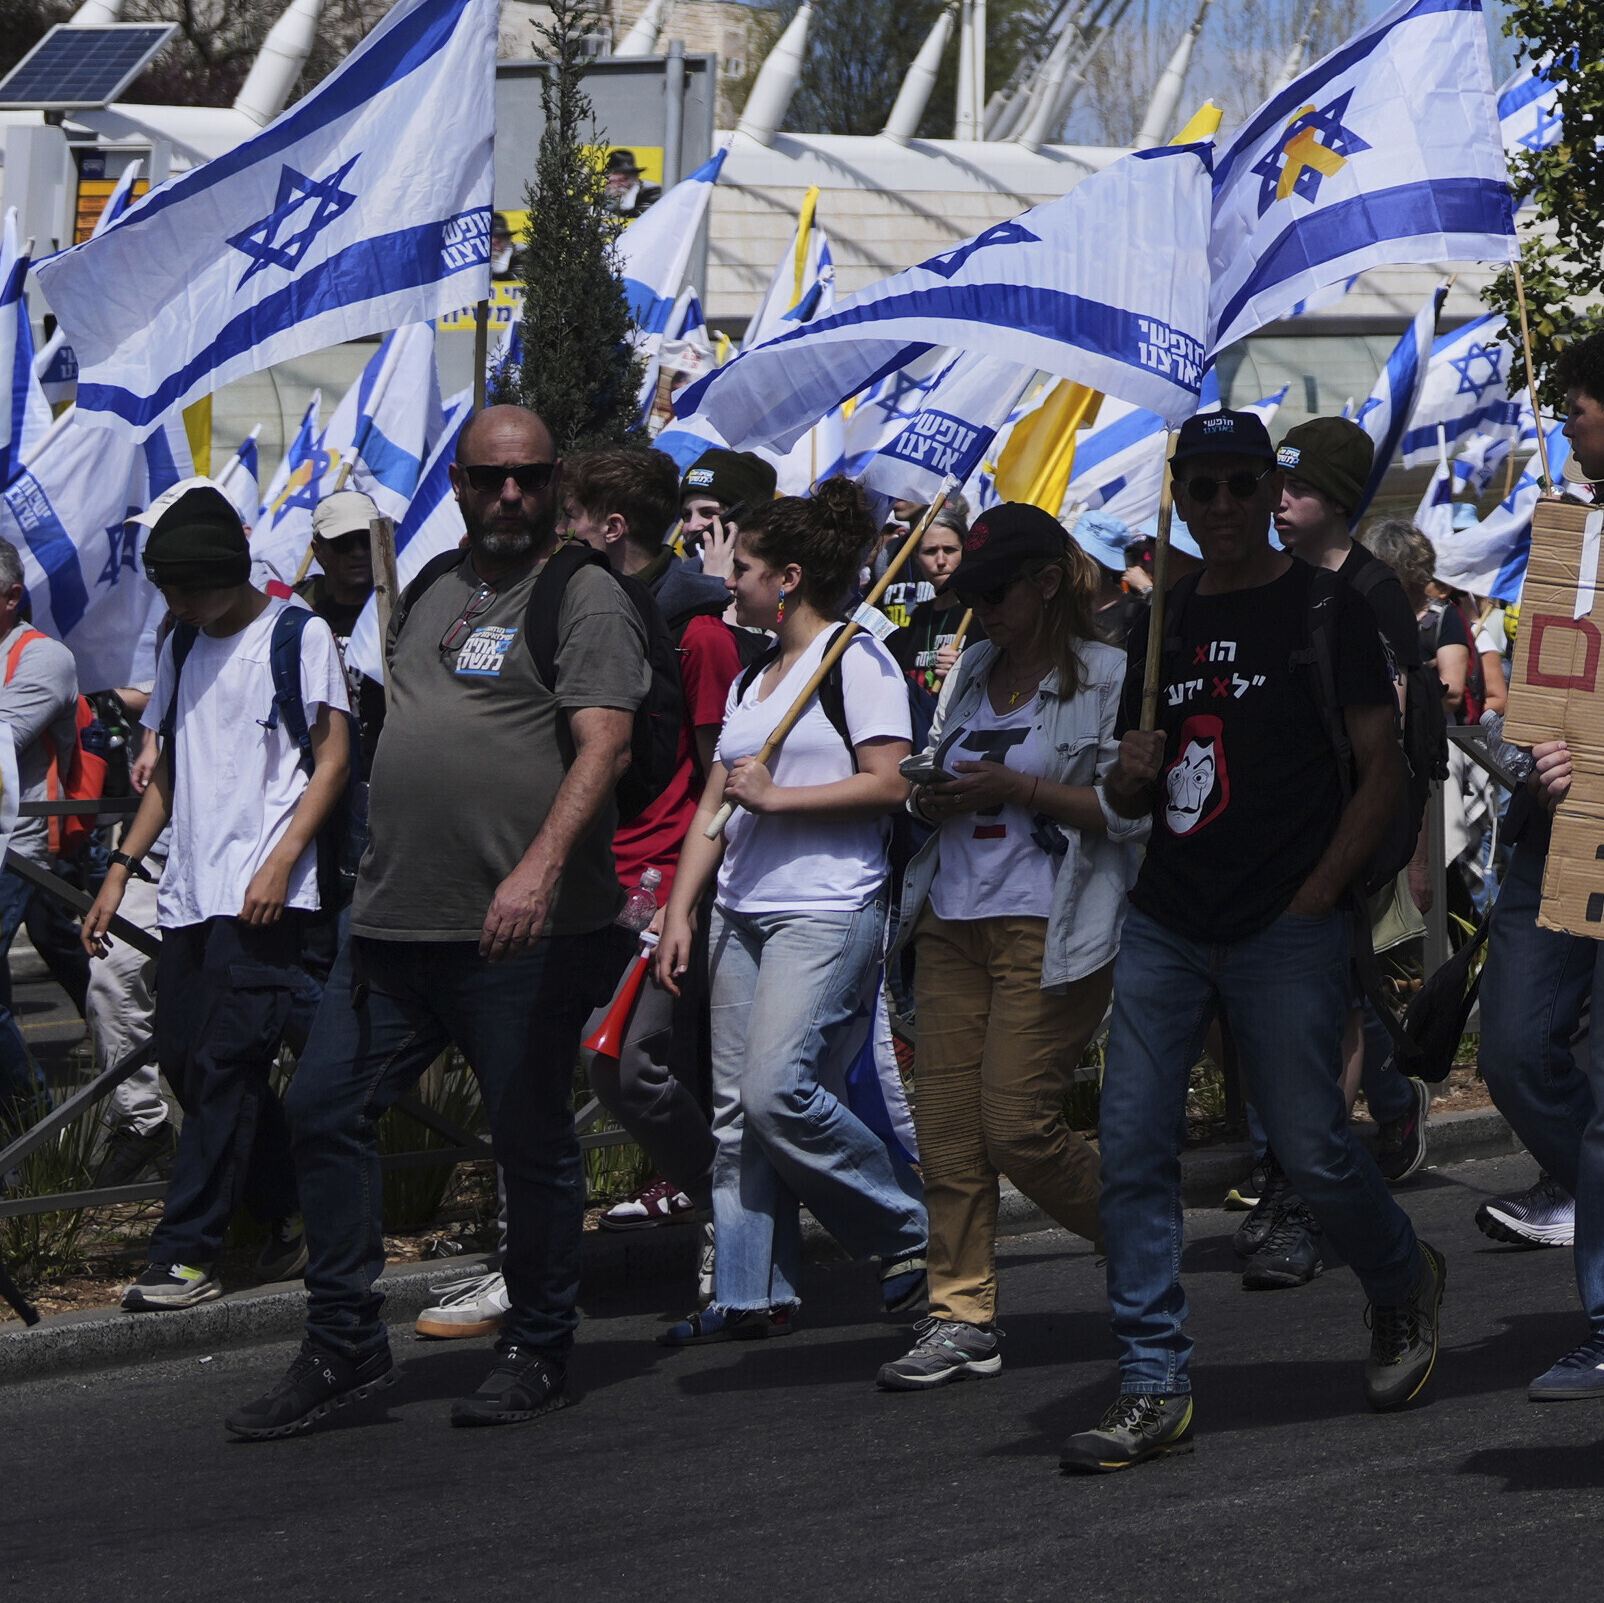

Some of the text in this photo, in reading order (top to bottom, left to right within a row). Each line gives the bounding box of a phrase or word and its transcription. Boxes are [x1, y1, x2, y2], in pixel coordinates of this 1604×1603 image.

[440, 236, 490, 270] ארצנו
[1138, 319, 1205, 370] חופשי
[1202, 416, 1234, 427] חופשי
[895, 431, 962, 474] ארצנו
[462, 637, 500, 655] אחים
[456, 652, 505, 671] לנשק
